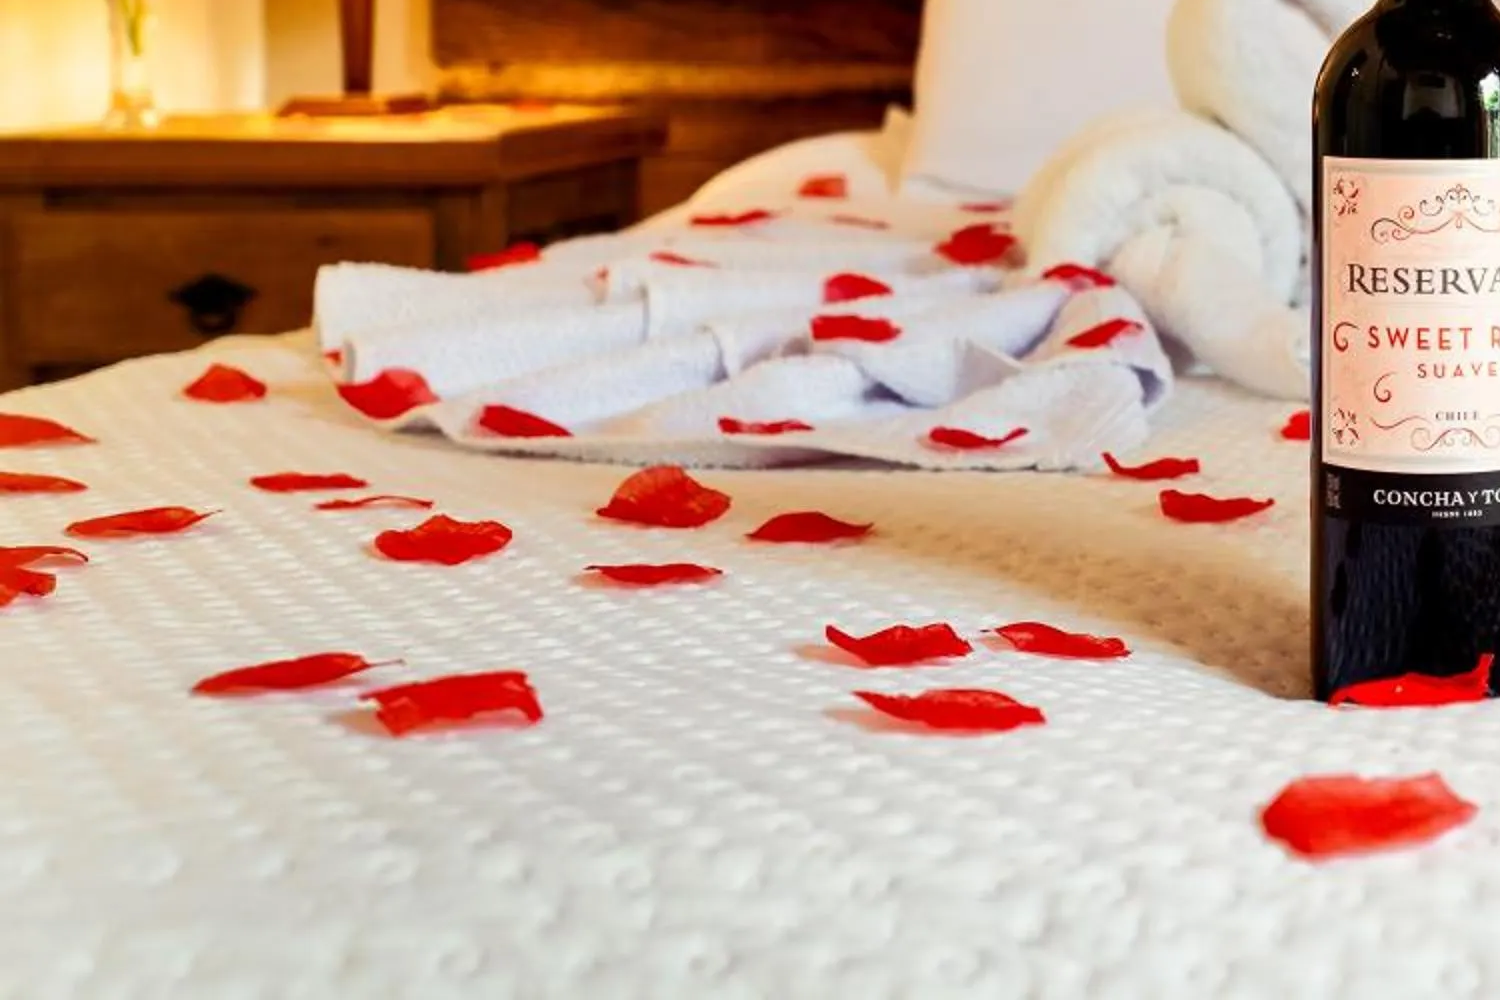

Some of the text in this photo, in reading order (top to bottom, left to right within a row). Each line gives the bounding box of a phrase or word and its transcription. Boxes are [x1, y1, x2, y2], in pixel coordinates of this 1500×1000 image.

[1367, 325, 1472, 351] SWEET
[1417, 361, 1499, 379] SUAVE
[1373, 488, 1465, 507] CONCHA
[1468, 490, 1479, 504] Y
